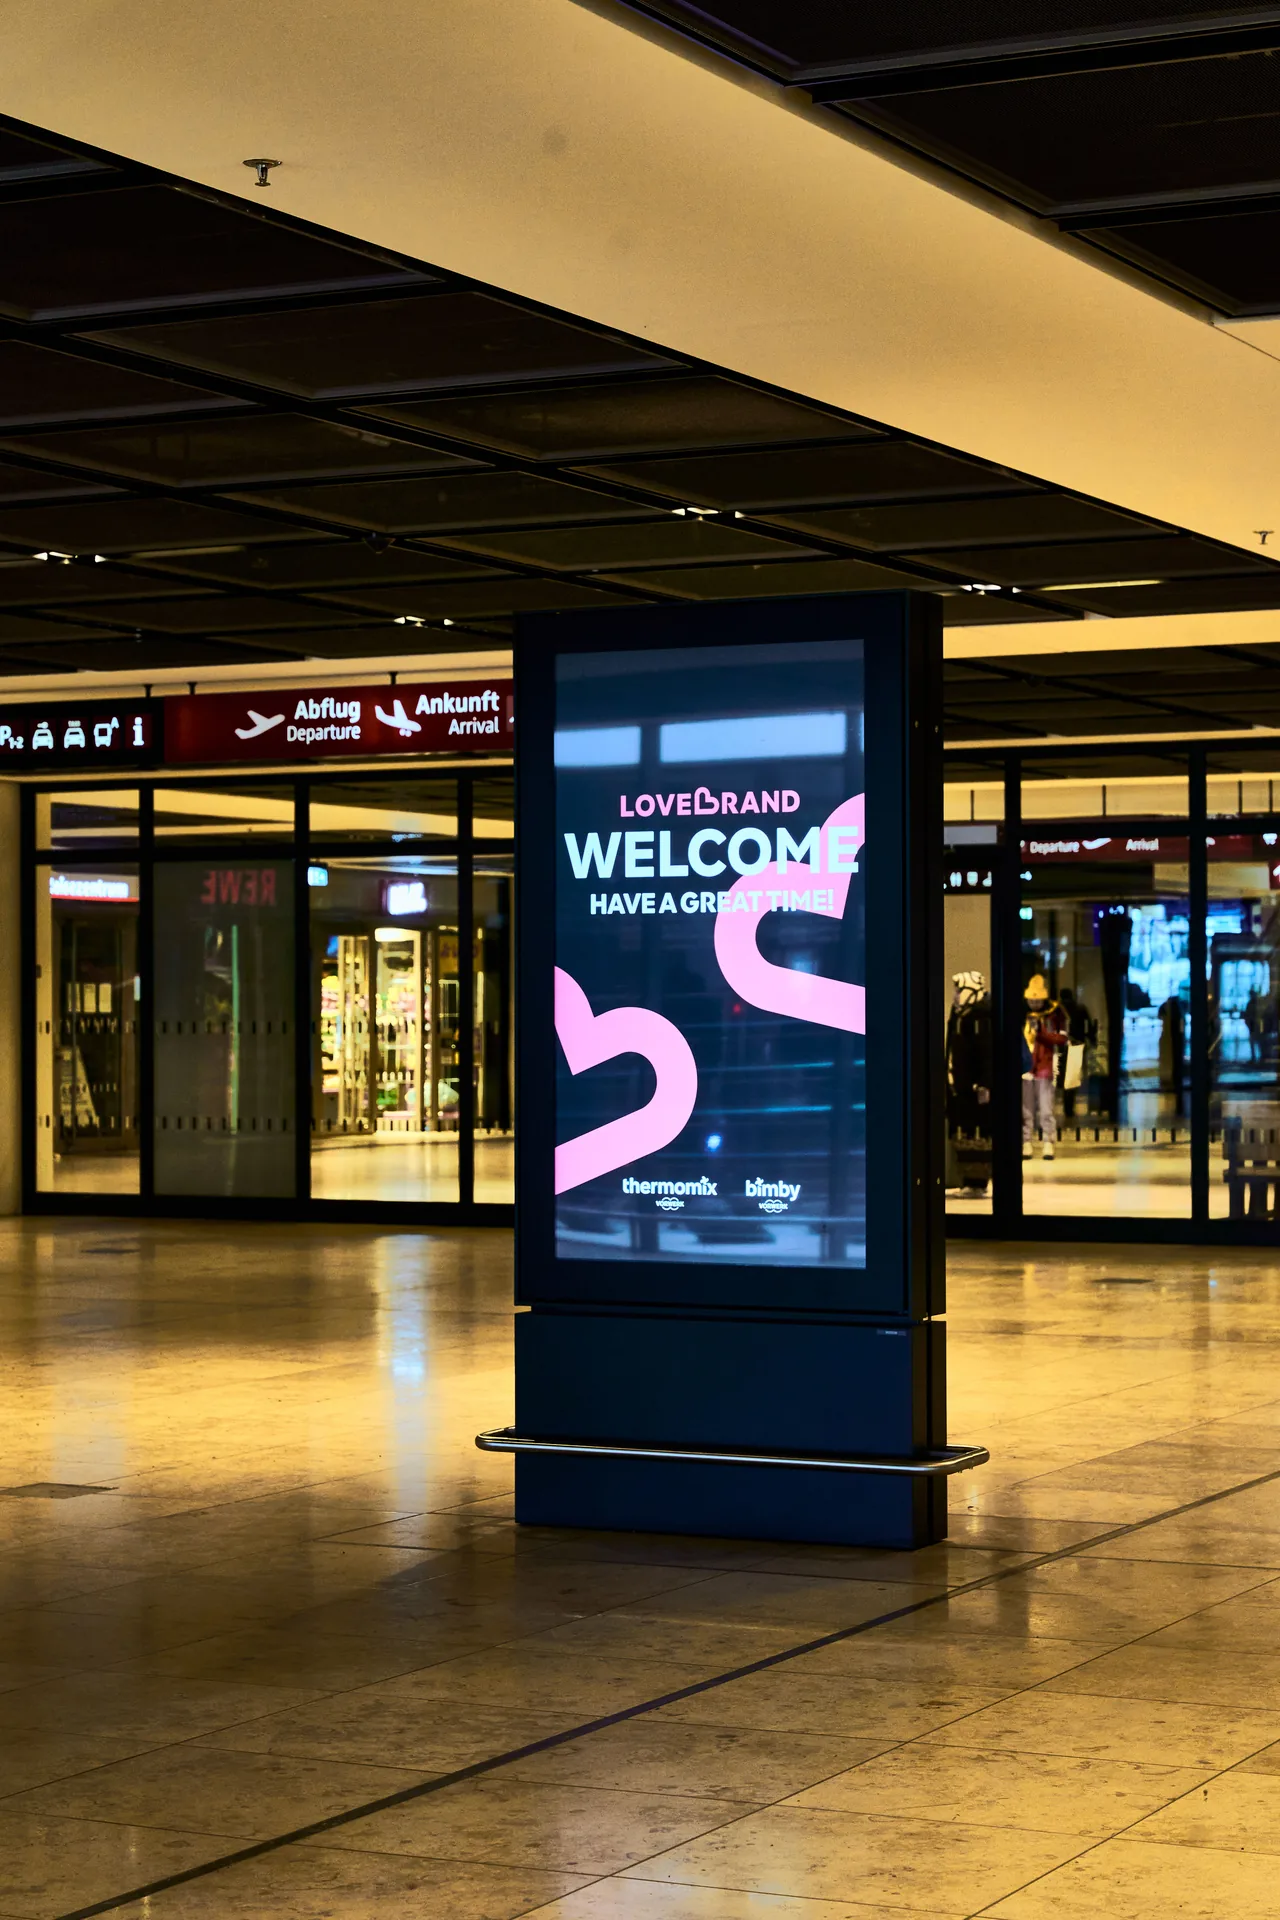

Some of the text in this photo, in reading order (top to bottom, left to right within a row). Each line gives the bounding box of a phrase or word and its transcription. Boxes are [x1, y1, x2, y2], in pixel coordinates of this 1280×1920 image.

[294, 697, 361, 723] Abflug
[415, 690, 500, 715] Ankunft
[286, 724, 361, 745] Departure
[448, 716, 500, 735] Arrival
[620, 786, 801, 818] LOVEBRAND
[564, 826, 859, 879] WELCOME
[1029, 840, 1080, 856] Departure
[1125, 838, 1160, 851] Arrival
[590, 889, 834, 915] HAVE A GREAT TIME!
[622, 1175, 718, 1196] thermomix
[745, 1177, 801, 1201] bimby
